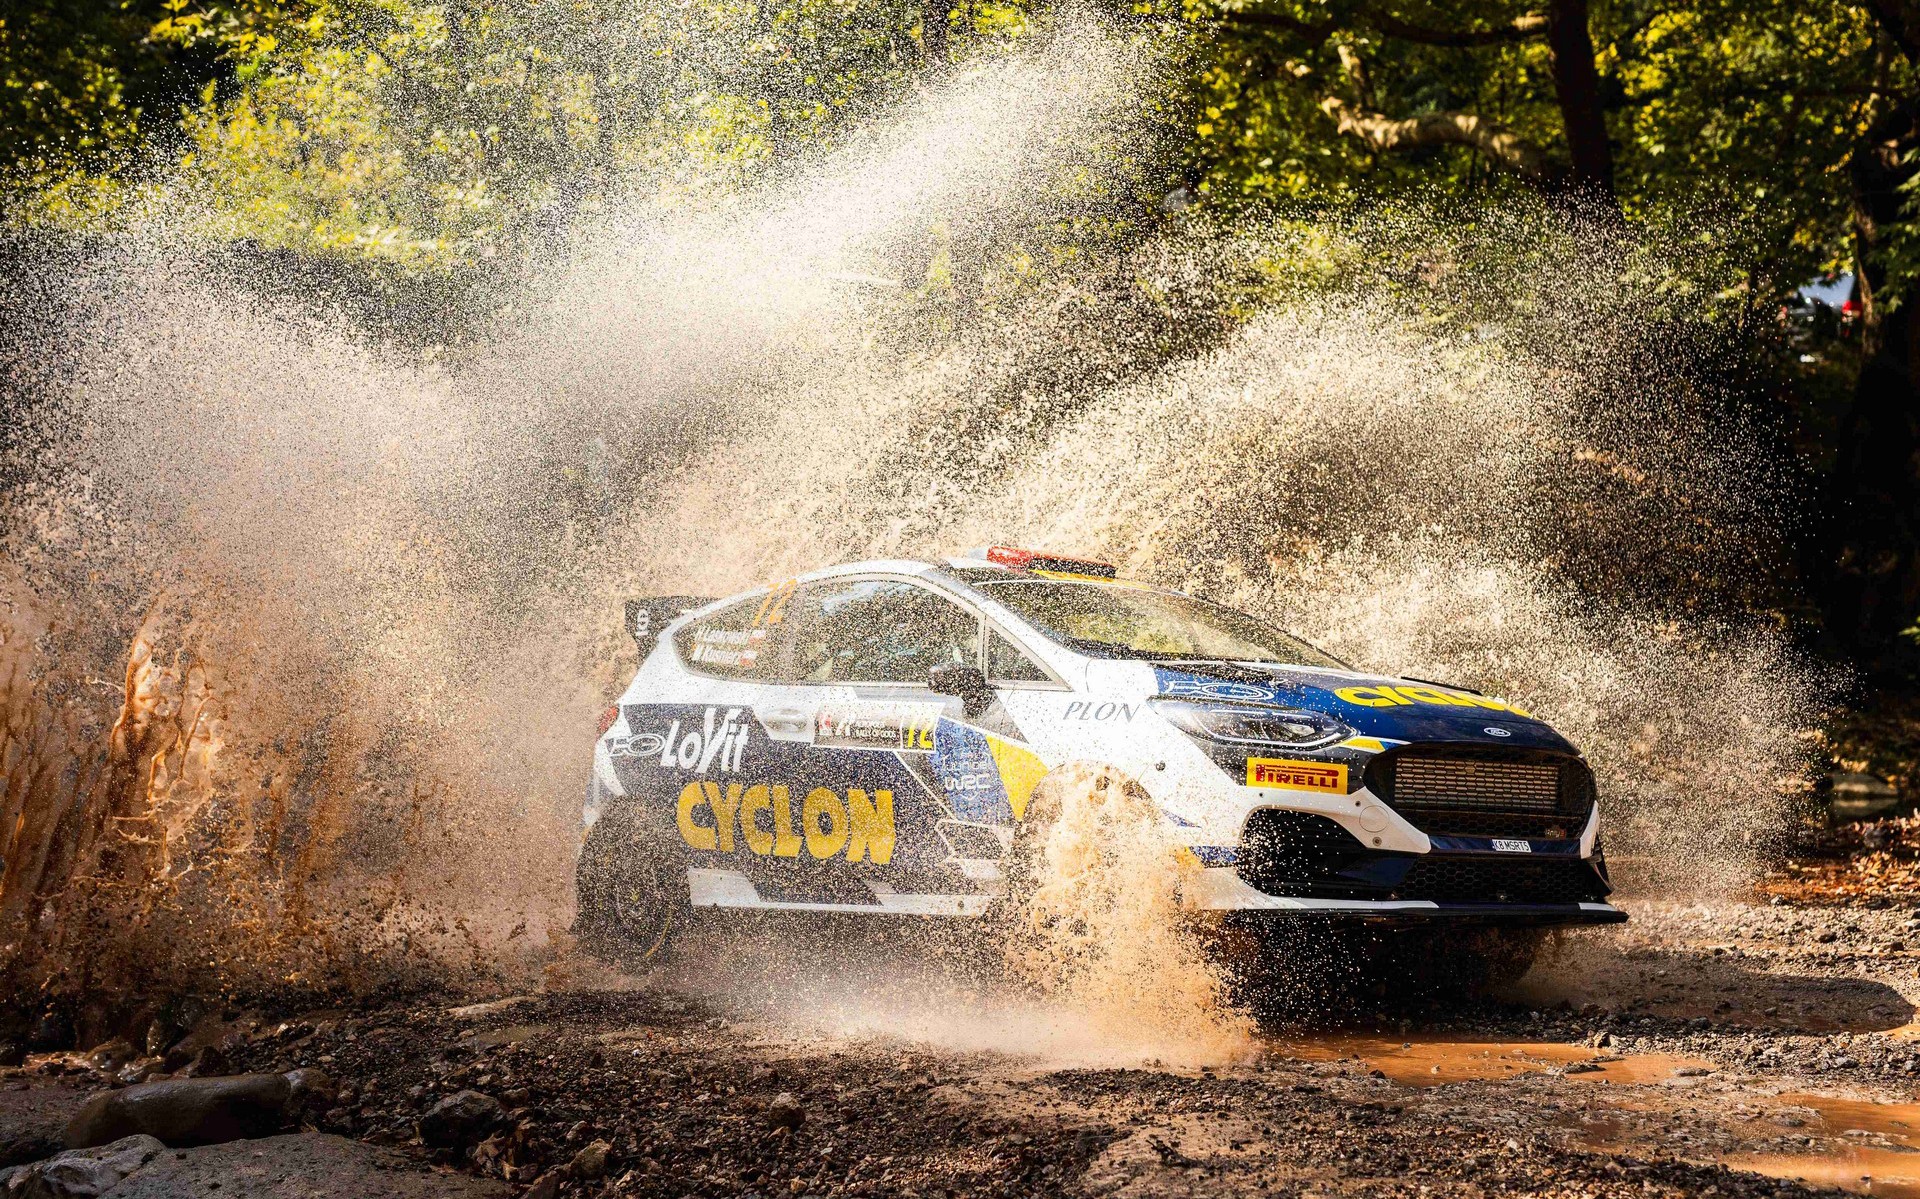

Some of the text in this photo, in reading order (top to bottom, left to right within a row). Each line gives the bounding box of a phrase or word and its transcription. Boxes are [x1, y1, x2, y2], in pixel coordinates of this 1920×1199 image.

[752, 578, 797, 627] 72
[1062, 701, 1141, 723] PLON
[1333, 685, 1541, 721] CYCL
[944, 774, 991, 791] WRC
[1255, 764, 1340, 789] PIRELLI
[677, 781, 895, 864] CYCLON
[1504, 840, 1530, 852] MSRT5
